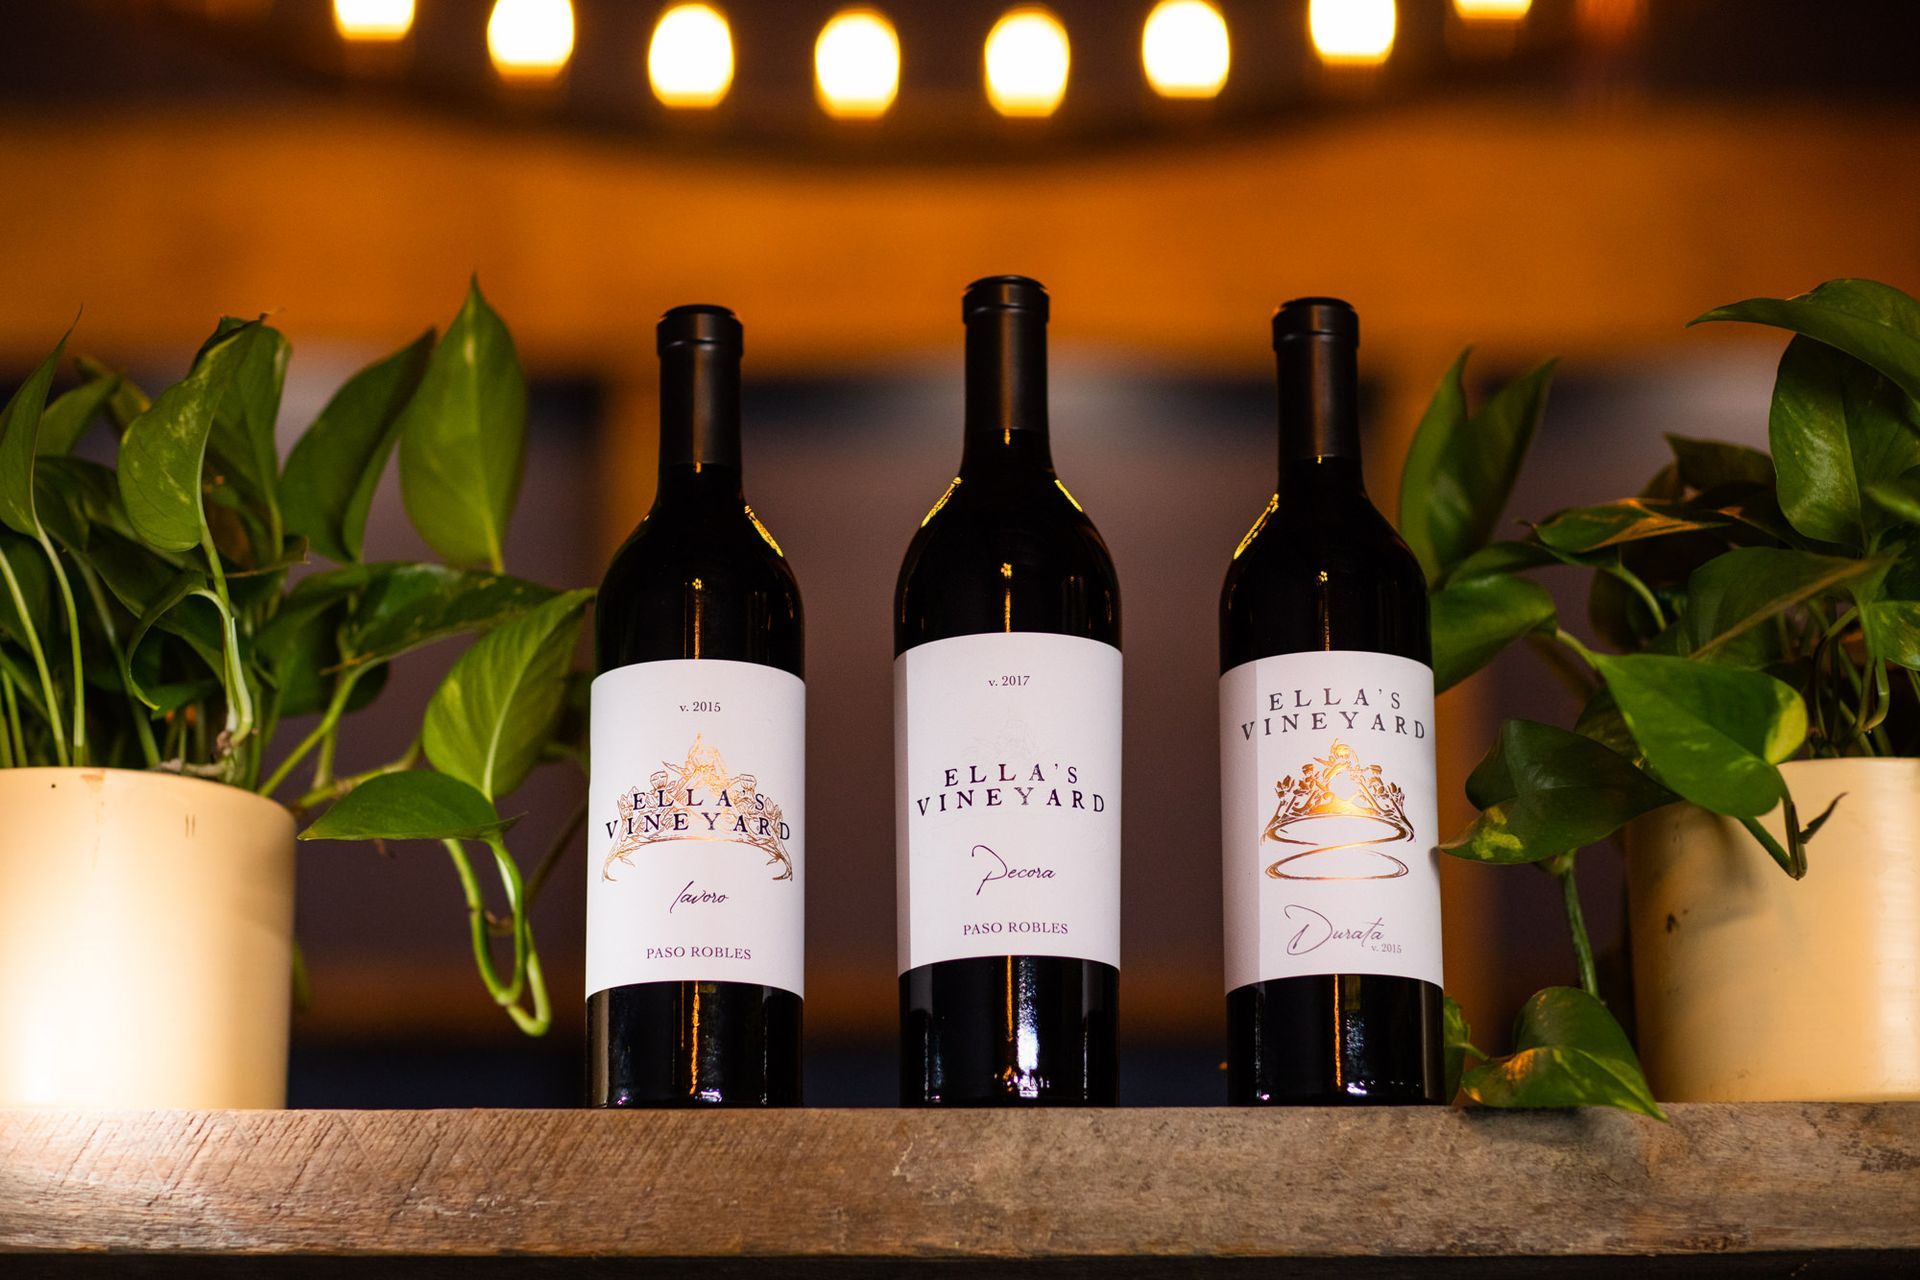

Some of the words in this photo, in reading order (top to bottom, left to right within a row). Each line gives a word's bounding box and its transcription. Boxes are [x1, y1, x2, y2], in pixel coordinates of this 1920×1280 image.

[1001, 675, 1030, 687] 2017
[679, 705, 690, 713] v.
[692, 701, 721, 713] 2015
[1269, 687, 1401, 712] ELLA'S
[1241, 711, 1425, 741] VINEYARD
[944, 763, 1078, 788] ELLA'S
[632, 788, 764, 811] ELLA'S
[917, 787, 1105, 817] VINEYARD
[606, 812, 790, 840] VINEYARD
[963, 922, 1003, 936] PASO
[1008, 922, 1069, 935] ROBLES
[1284, 904, 1384, 956] Durata
[646, 946, 686, 960] PASO
[690, 946, 751, 960] ROBLES
[1381, 943, 1402, 954] 2015
